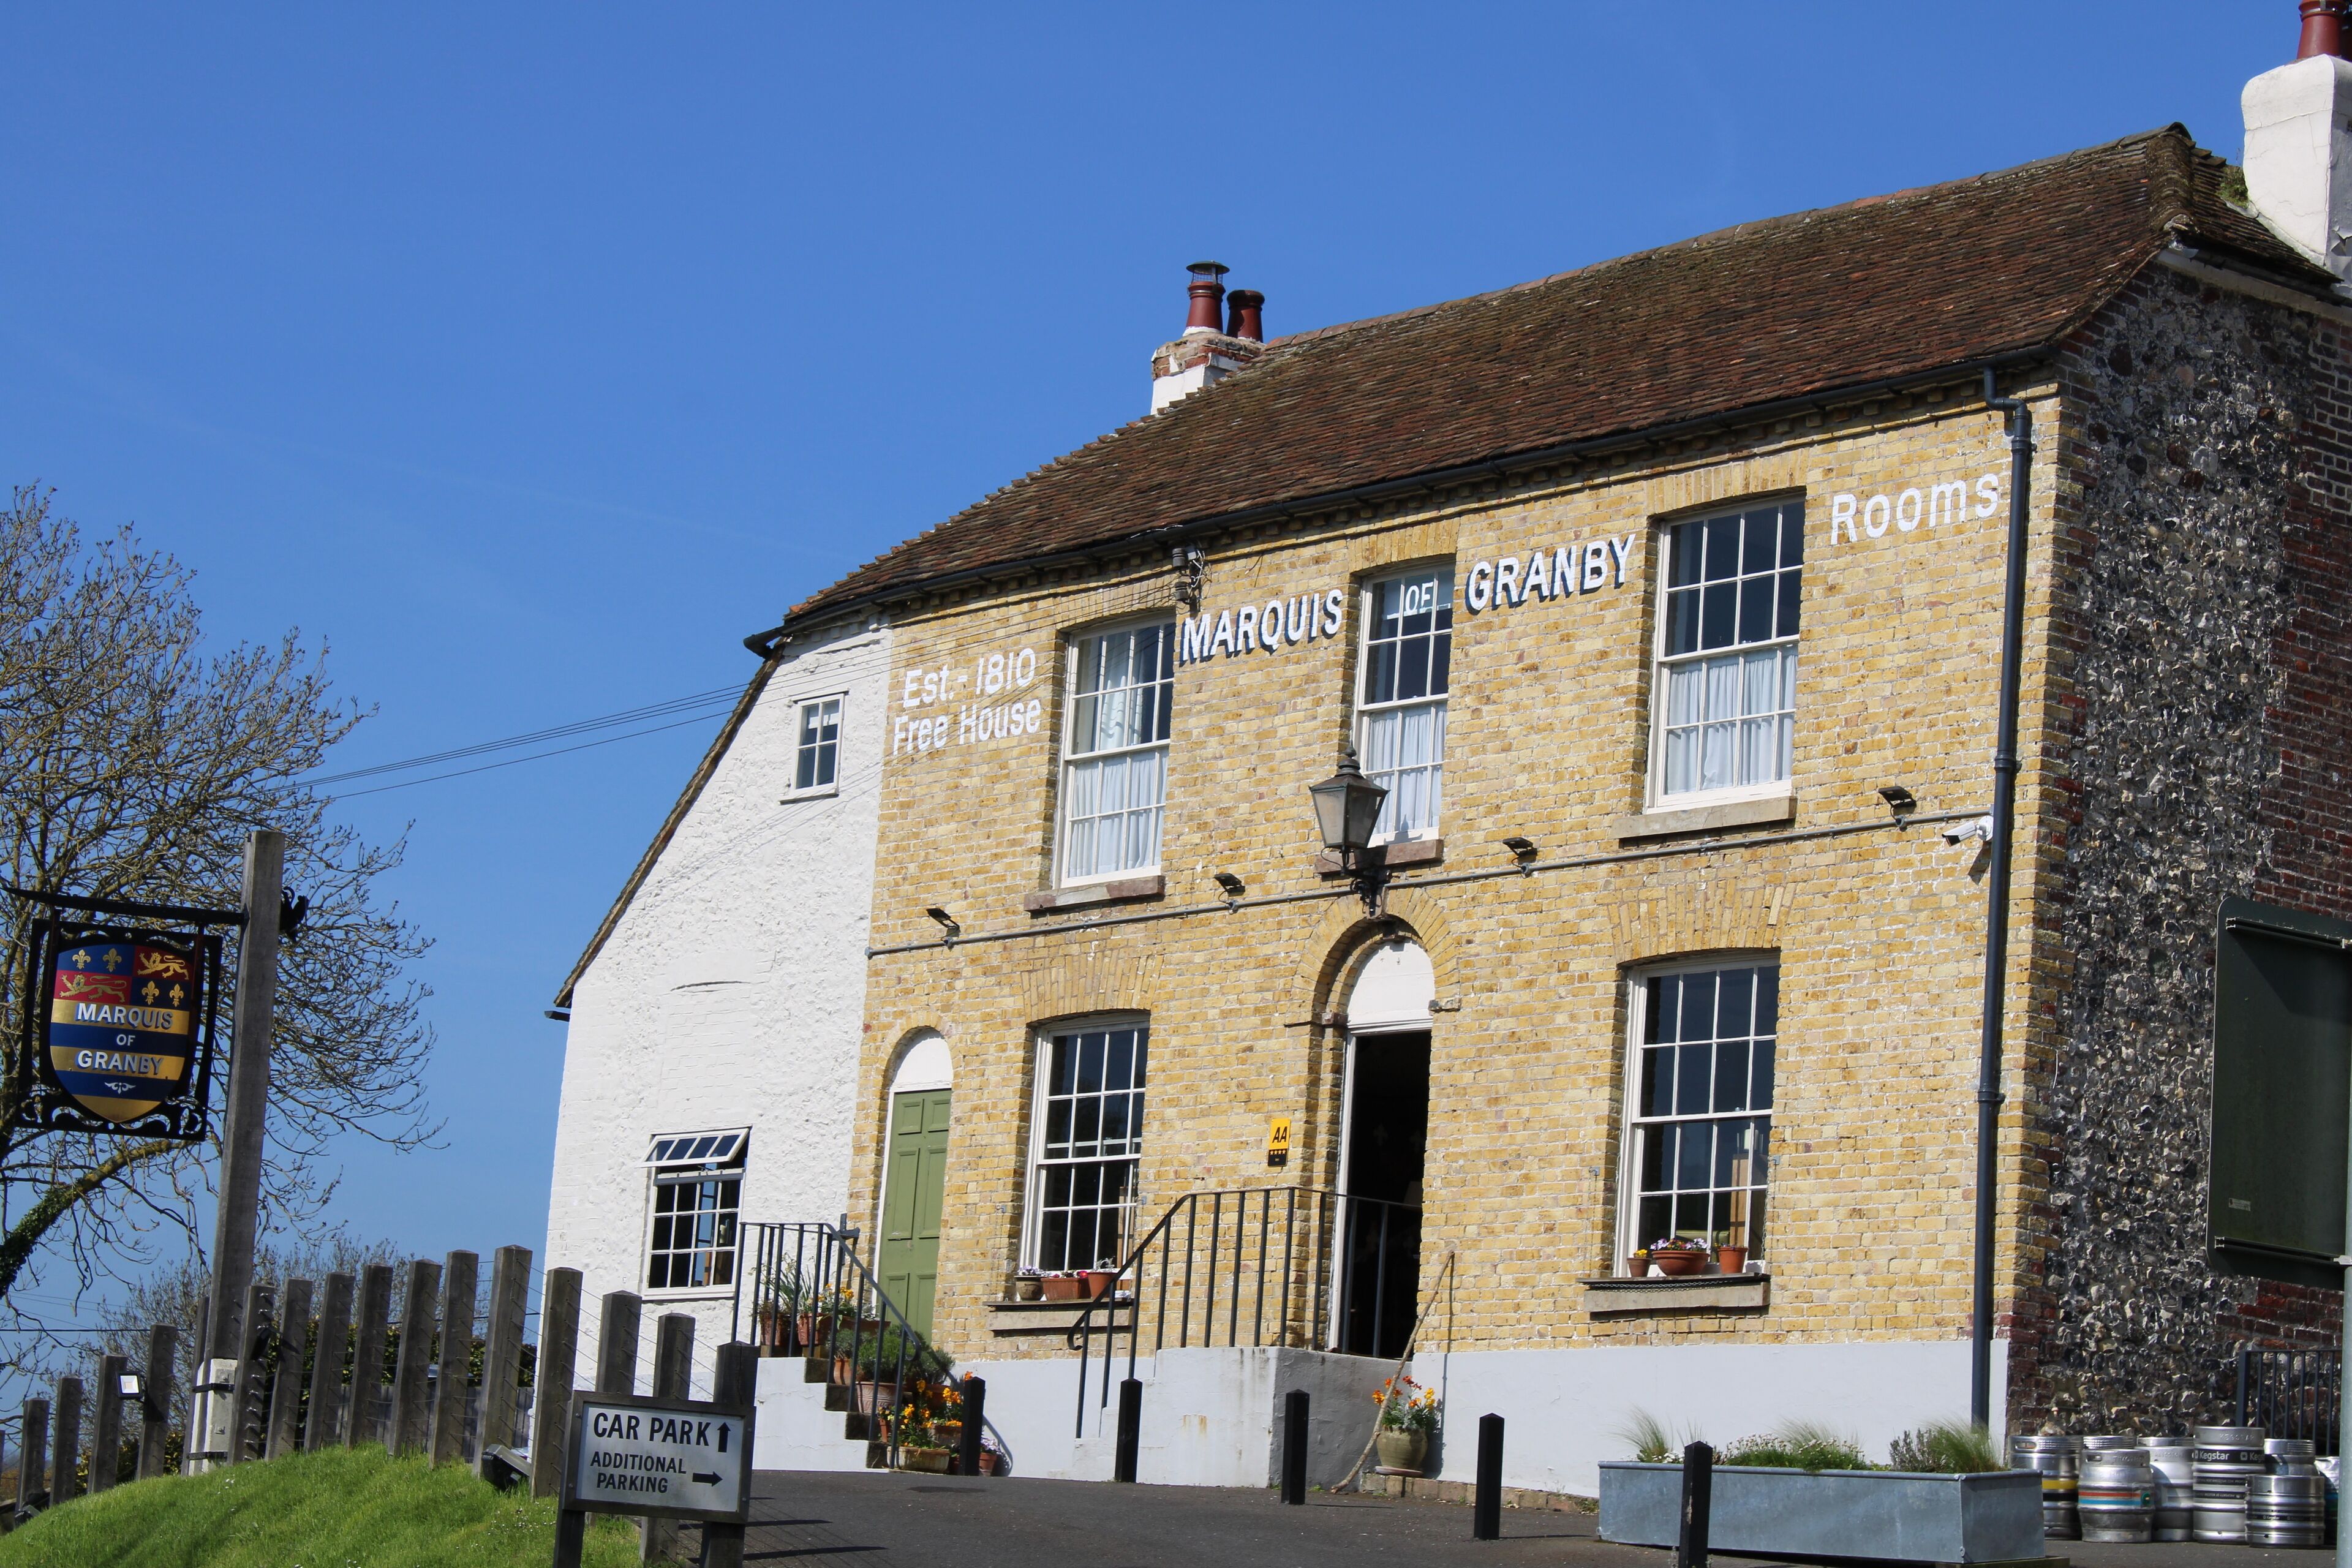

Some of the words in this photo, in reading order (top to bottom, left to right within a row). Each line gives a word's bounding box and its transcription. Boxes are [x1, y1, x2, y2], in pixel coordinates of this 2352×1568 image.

[1180, 589, 1343, 662] MARQUIS
[1404, 581, 1434, 612] OF
[1465, 534, 1635, 613] GRANBY
[976, 648, 1036, 695] 1810
[893, 714, 948, 755] Free
[959, 699, 1041, 744] House
[75, 1003, 173, 1030] MARQUIS
[116, 1034, 135, 1046] OF
[75, 1050, 164, 1075] GRANBY
[1272, 1126, 1288, 1144] AA
[594, 1412, 640, 1441] CAR
[649, 1417, 711, 1446] PARK
[590, 1451, 687, 1474] ADDITIONAL
[2199, 1451, 2230, 1462] Kegstar
[597, 1472, 668, 1494] PARKING
